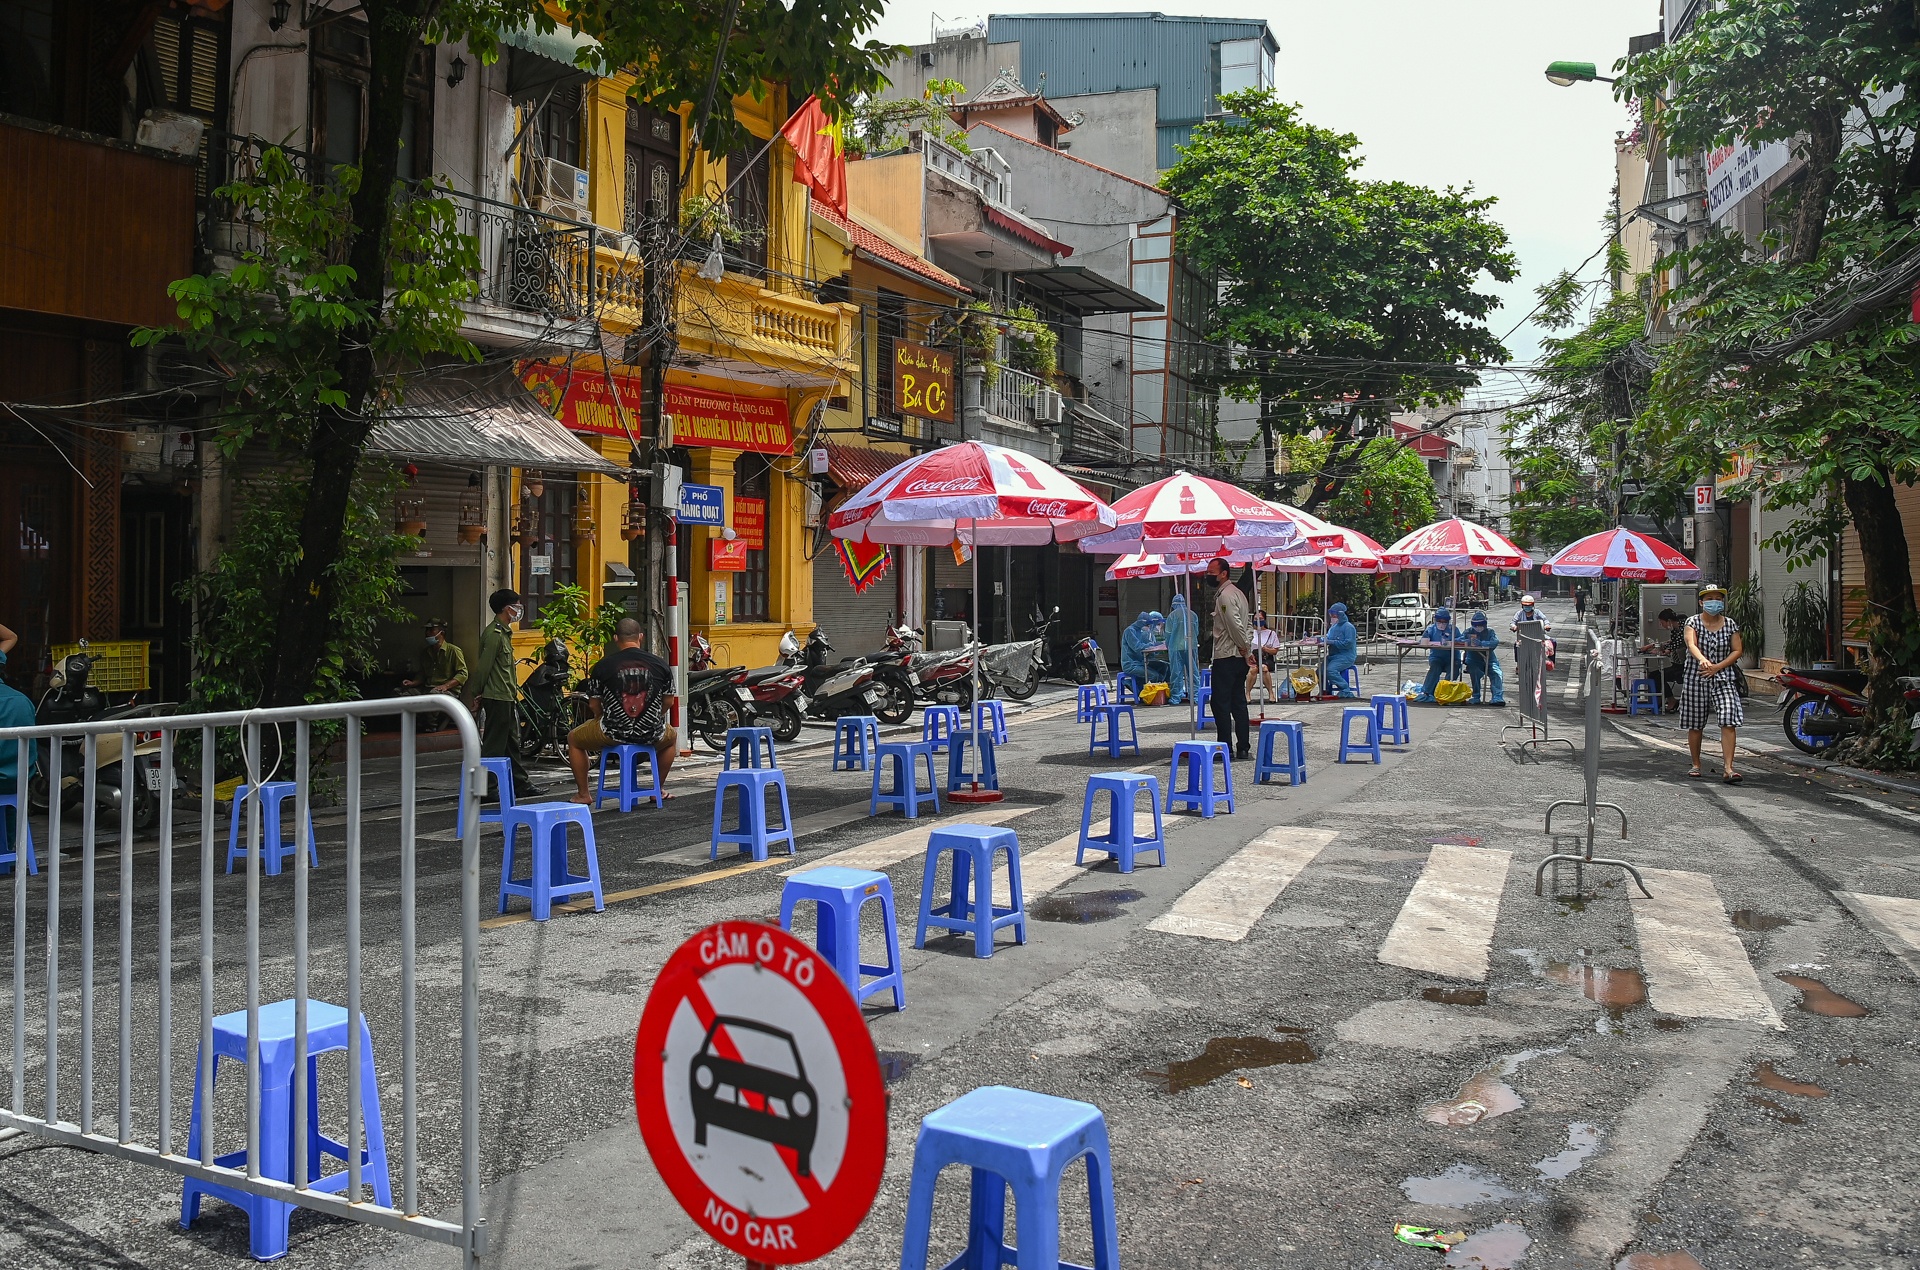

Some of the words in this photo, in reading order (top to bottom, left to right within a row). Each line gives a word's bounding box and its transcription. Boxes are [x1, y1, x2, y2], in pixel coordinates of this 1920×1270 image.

[582, 380, 604, 394] CÁN
[623, 386, 638, 398] VÀ
[671, 393, 692, 406] DÂN
[758, 405, 774, 416] GAI
[902, 374, 922, 409] Ba
[926, 382, 947, 414] Cô
[692, 414, 731, 441] NGHIÊM
[769, 420, 787, 446] TRÚ
[905, 475, 984, 494] Coca-Cola
[692, 490, 708, 501] PHỐ
[1697, 487, 1712, 504] 57
[680, 500, 700, 518] HÀNG
[702, 505, 719, 522] QUẠT
[1027, 500, 1068, 517] Coca-Cola
[1232, 504, 1274, 517] Coca-Cola
[1170, 522, 1208, 535] Coca-Cola
[1620, 568, 1648, 578] Coca-Cola
[699, 924, 749, 965] CẤM
[756, 932, 774, 963] Ô
[783, 948, 815, 987] TÔ
[703, 1198, 740, 1236] NO
[744, 1222, 798, 1250] CAR
